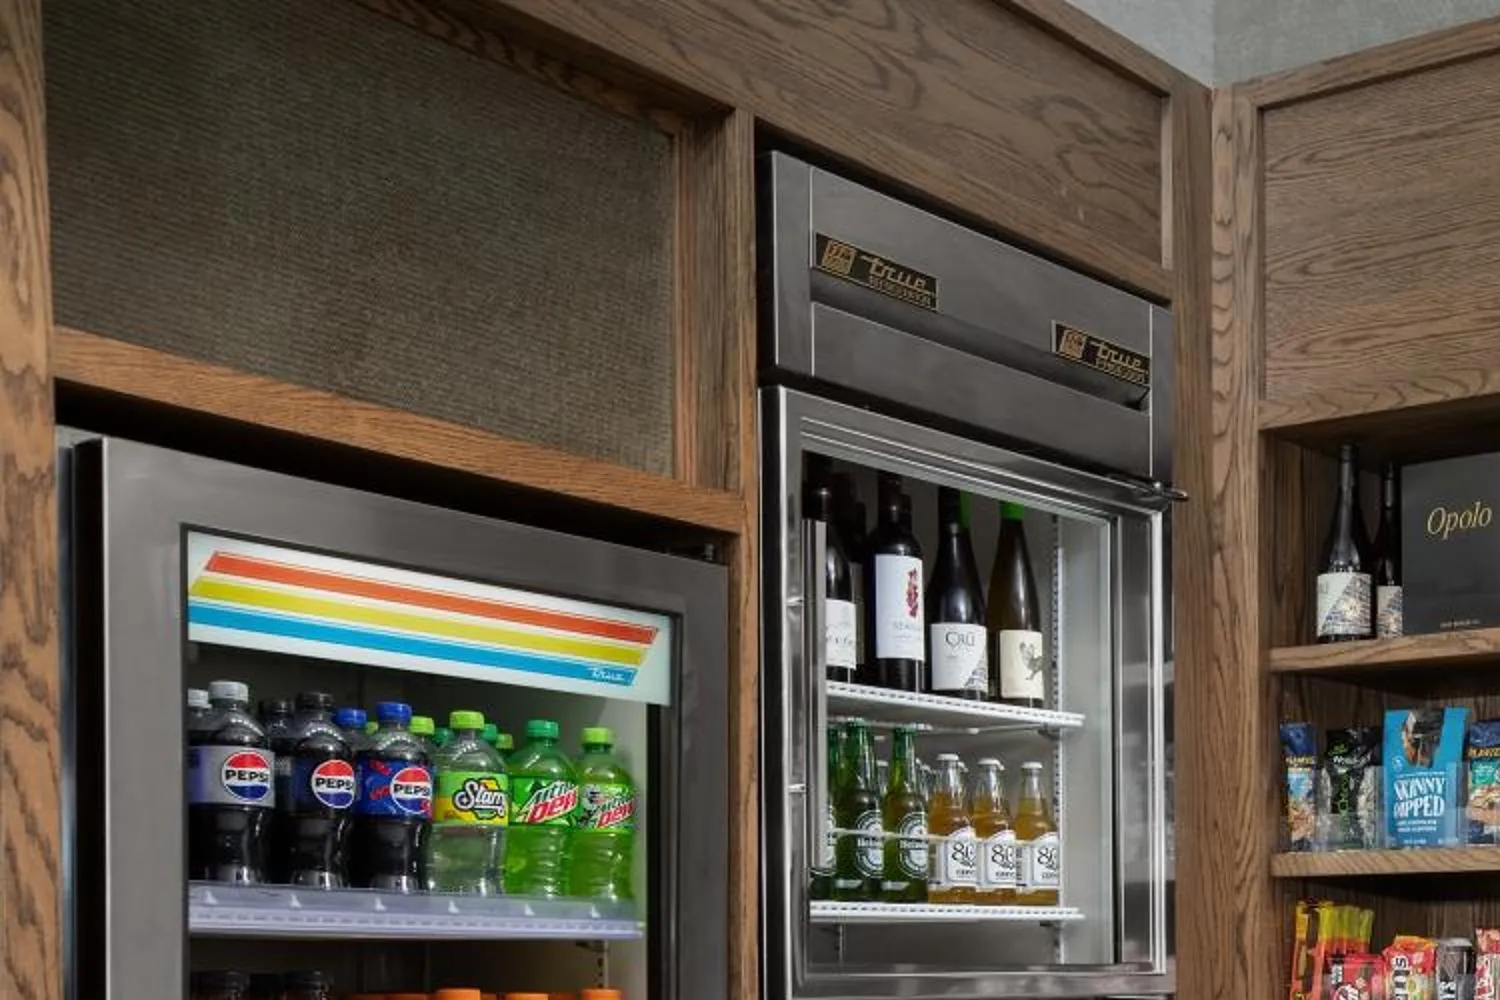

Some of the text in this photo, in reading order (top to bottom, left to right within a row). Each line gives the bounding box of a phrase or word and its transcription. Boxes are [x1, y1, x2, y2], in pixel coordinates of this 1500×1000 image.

[1425, 500, 1493, 540] Opolo
[225, 769, 269, 783] PEPS
[315, 776, 355, 790] PEPS
[394, 782, 431, 796] PEPS
[1394, 795, 1445, 819] DIPPED
